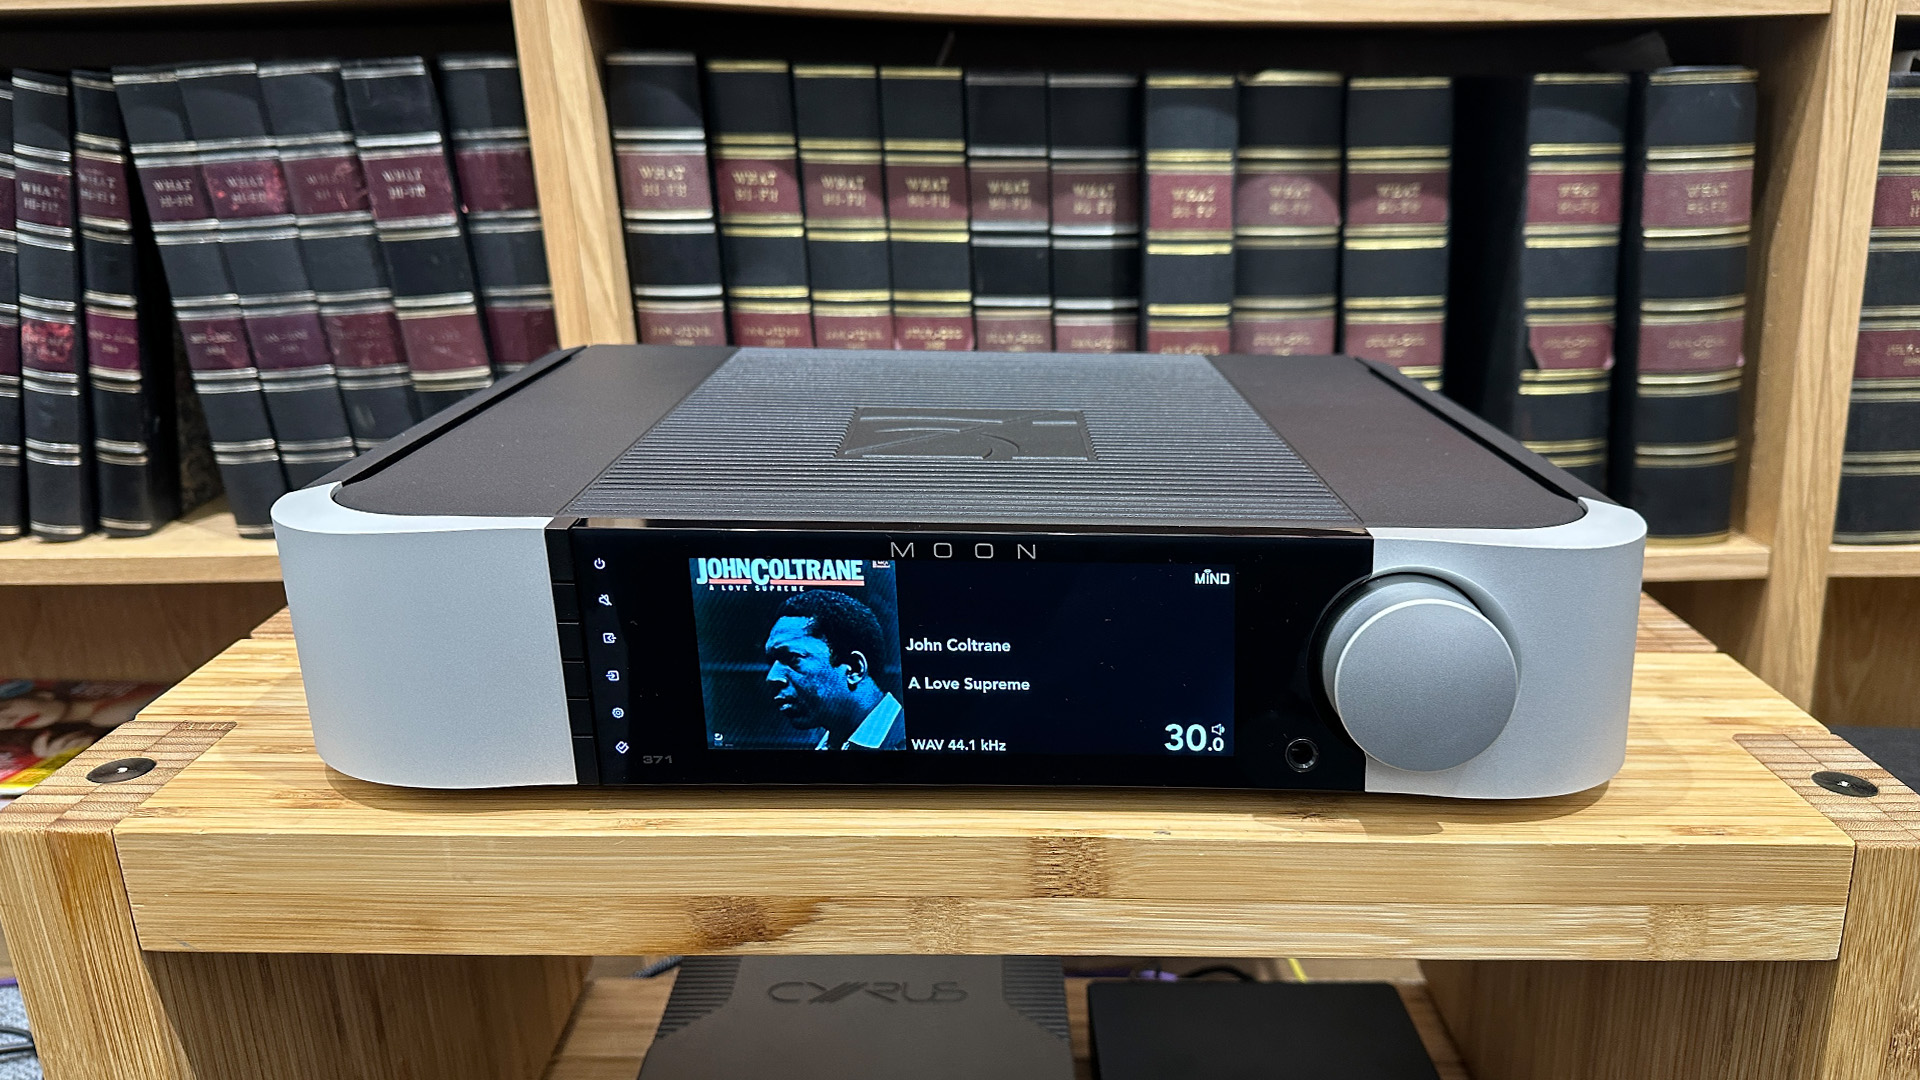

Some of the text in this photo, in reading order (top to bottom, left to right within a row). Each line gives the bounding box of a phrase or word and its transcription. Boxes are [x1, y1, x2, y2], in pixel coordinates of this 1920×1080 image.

[381, 166, 423, 182] WHAT
[21, 180, 61, 197] WHAT
[153, 178, 193, 192] WHAT
[890, 542, 1037, 559] MOON
[906, 638, 1011, 652] John Coltrane
[908, 677, 1030, 693] A Love Supreme
[911, 738, 1007, 751] WAV 44.1 kHz
[642, 756, 673, 765] 371
[767, 981, 969, 1003] CYRUS
